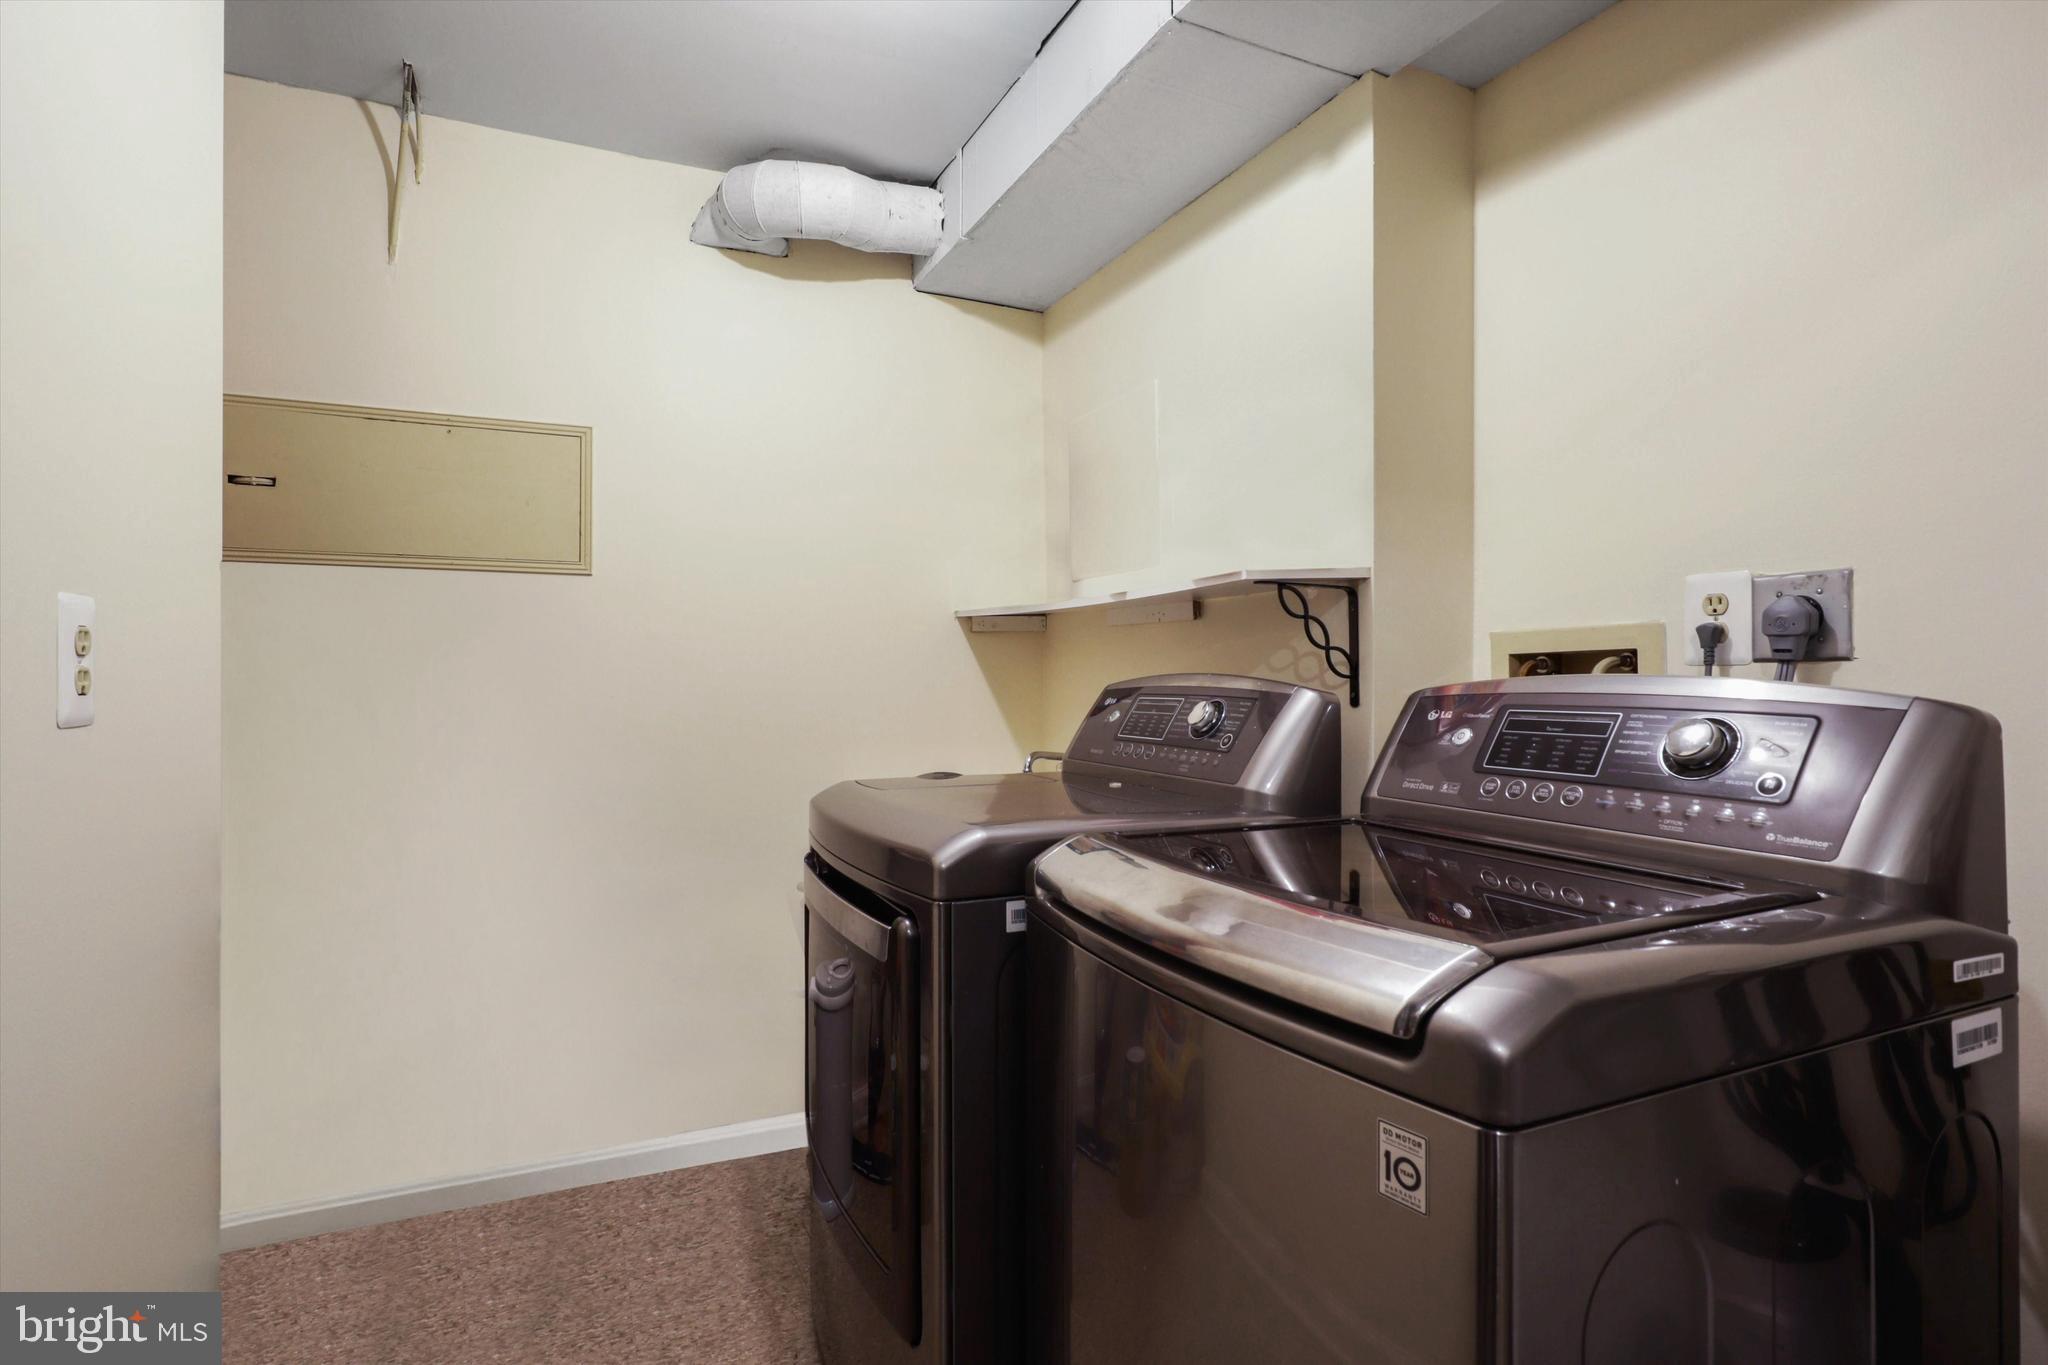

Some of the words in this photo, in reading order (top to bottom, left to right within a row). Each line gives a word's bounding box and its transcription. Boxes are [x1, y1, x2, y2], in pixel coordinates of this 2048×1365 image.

[1439, 710, 1453, 719] LG
[1776, 834, 1829, 848] TrueBalance
[1383, 1126, 1394, 1138] DD
[1395, 1133, 1422, 1149] MOTOR
[1384, 1149, 1422, 1192] 10
[1399, 1168, 1415, 1180] YEAR
[1384, 1183, 1422, 1204] WARRANTY
